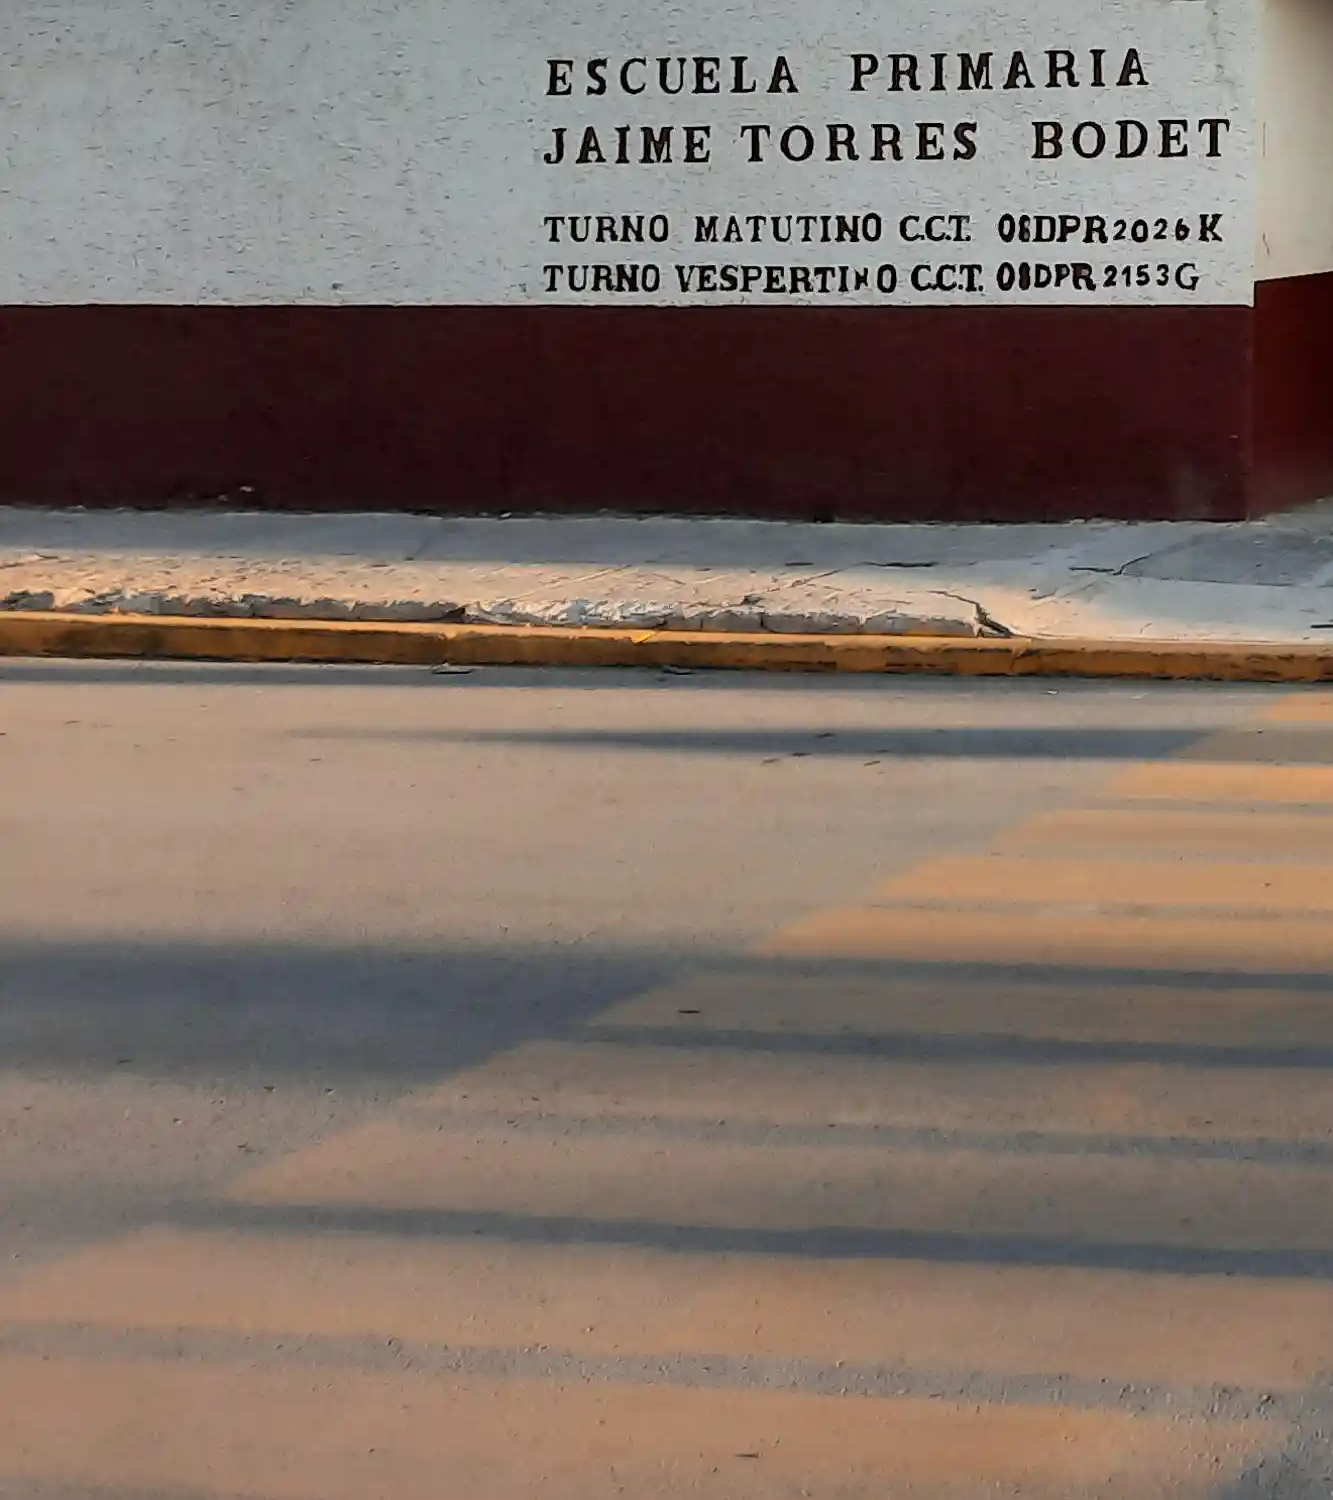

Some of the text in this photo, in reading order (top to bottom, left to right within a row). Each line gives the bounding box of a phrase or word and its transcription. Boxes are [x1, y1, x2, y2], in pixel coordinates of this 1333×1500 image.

[546, 48, 1149, 95] ESCUELA PRIMARIA
[544, 119, 1230, 164] JAIME TORRES BODET
[544, 215, 668, 242] TURNO
[695, 213, 881, 242] MATUTINO
[543, 264, 660, 292] TURNO
[675, 264, 897, 294] VESPERTINO
